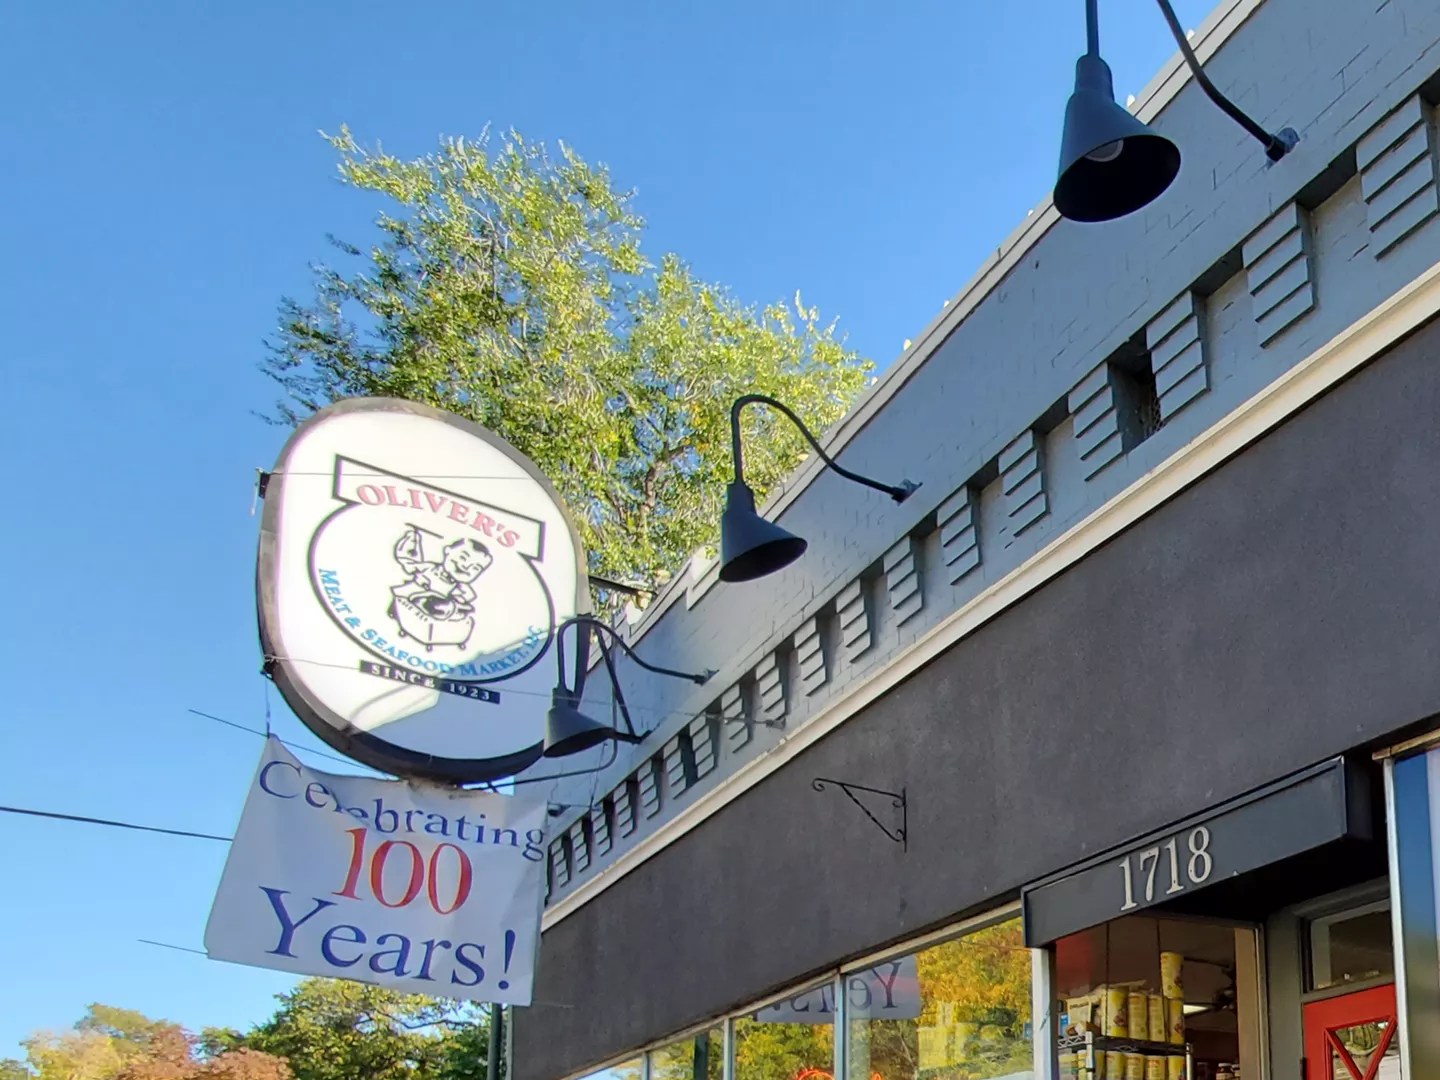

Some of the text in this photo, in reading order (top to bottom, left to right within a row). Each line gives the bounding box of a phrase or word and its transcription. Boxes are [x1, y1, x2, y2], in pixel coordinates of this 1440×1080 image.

[356, 484, 521, 548] OLIVER'S
[318, 568, 353, 613] MEAT
[343, 615, 362, 630] &
[360, 628, 455, 674] SEAFOOD
[371, 663, 490, 700] SINCE 1923
[332, 827, 473, 916] 100
[1118, 825, 1213, 911] 1718
[258, 885, 516, 990] Years!
